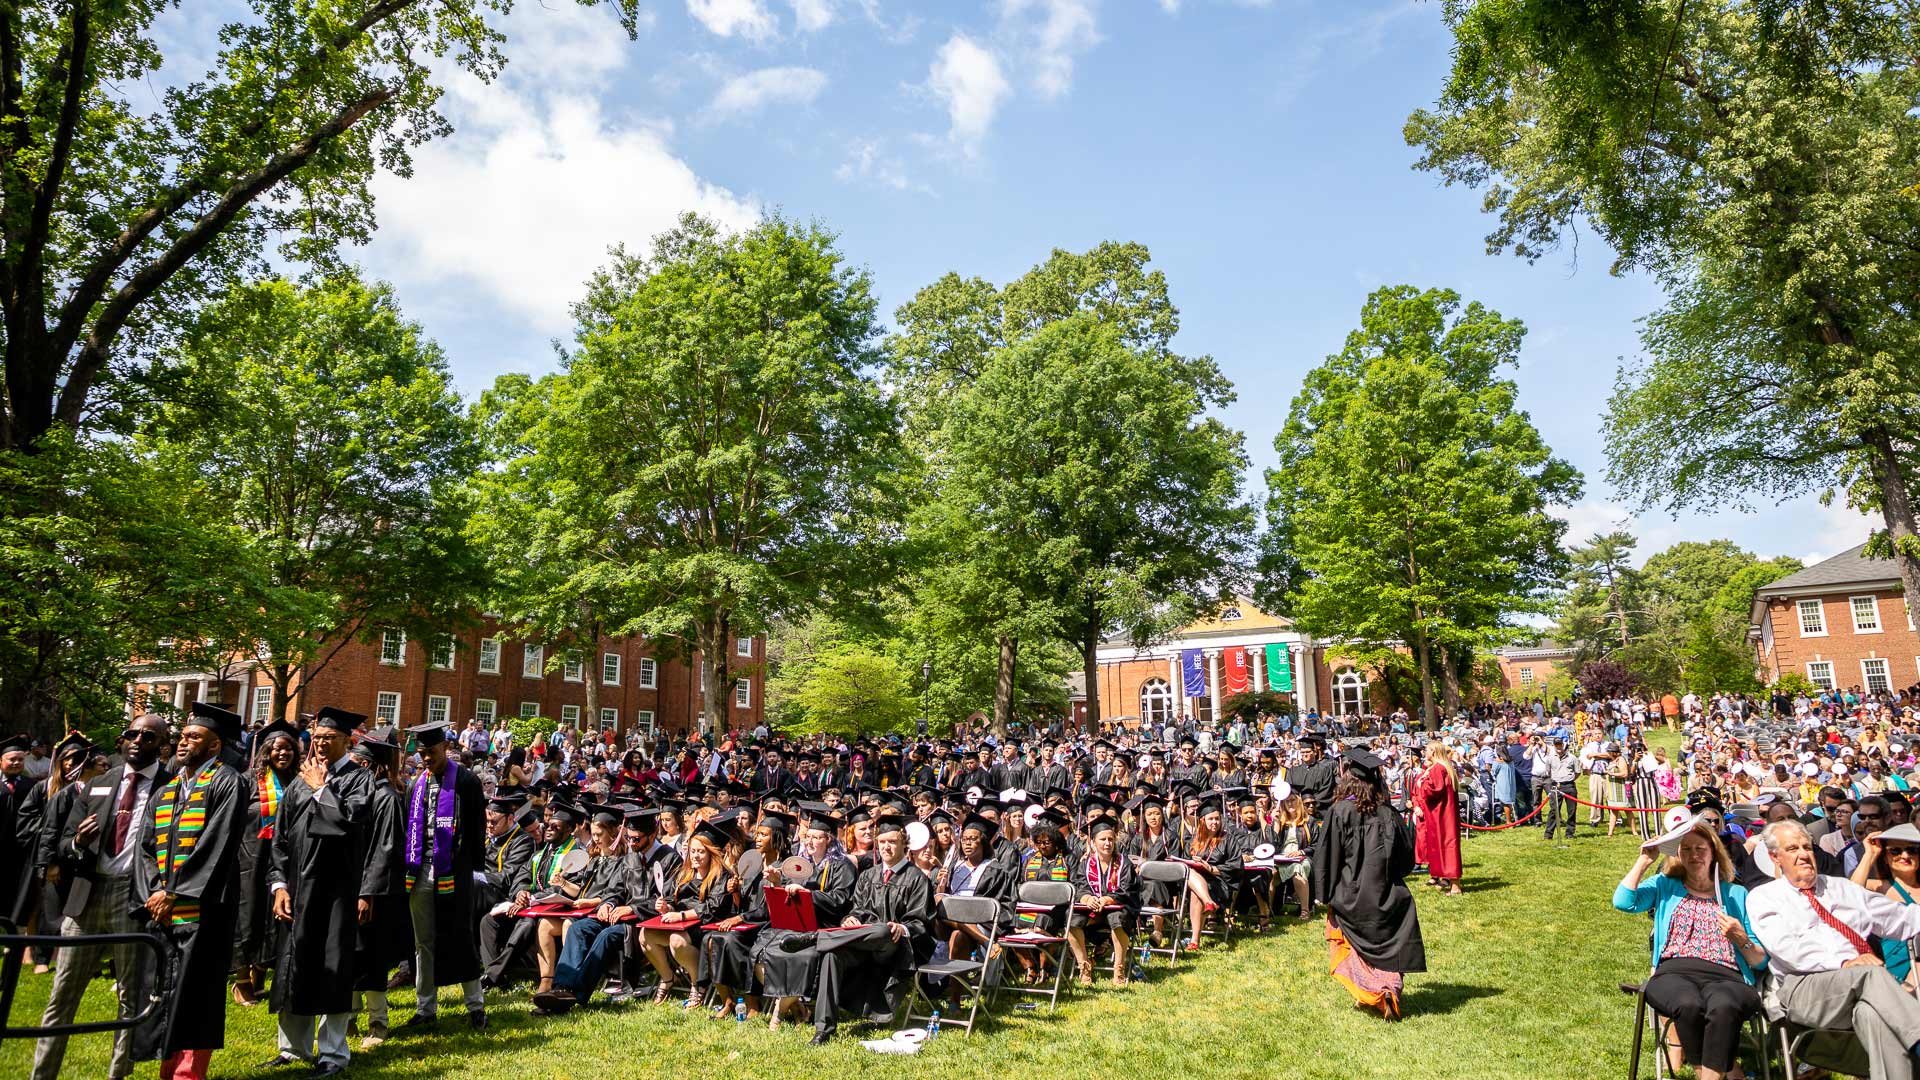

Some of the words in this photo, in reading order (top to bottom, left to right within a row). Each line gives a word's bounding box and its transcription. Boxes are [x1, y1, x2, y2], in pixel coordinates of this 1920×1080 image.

[1194, 654, 1202, 670] HEGE
[1236, 651, 1244, 667] HEGE
[1278, 648, 1288, 664] HEGE
